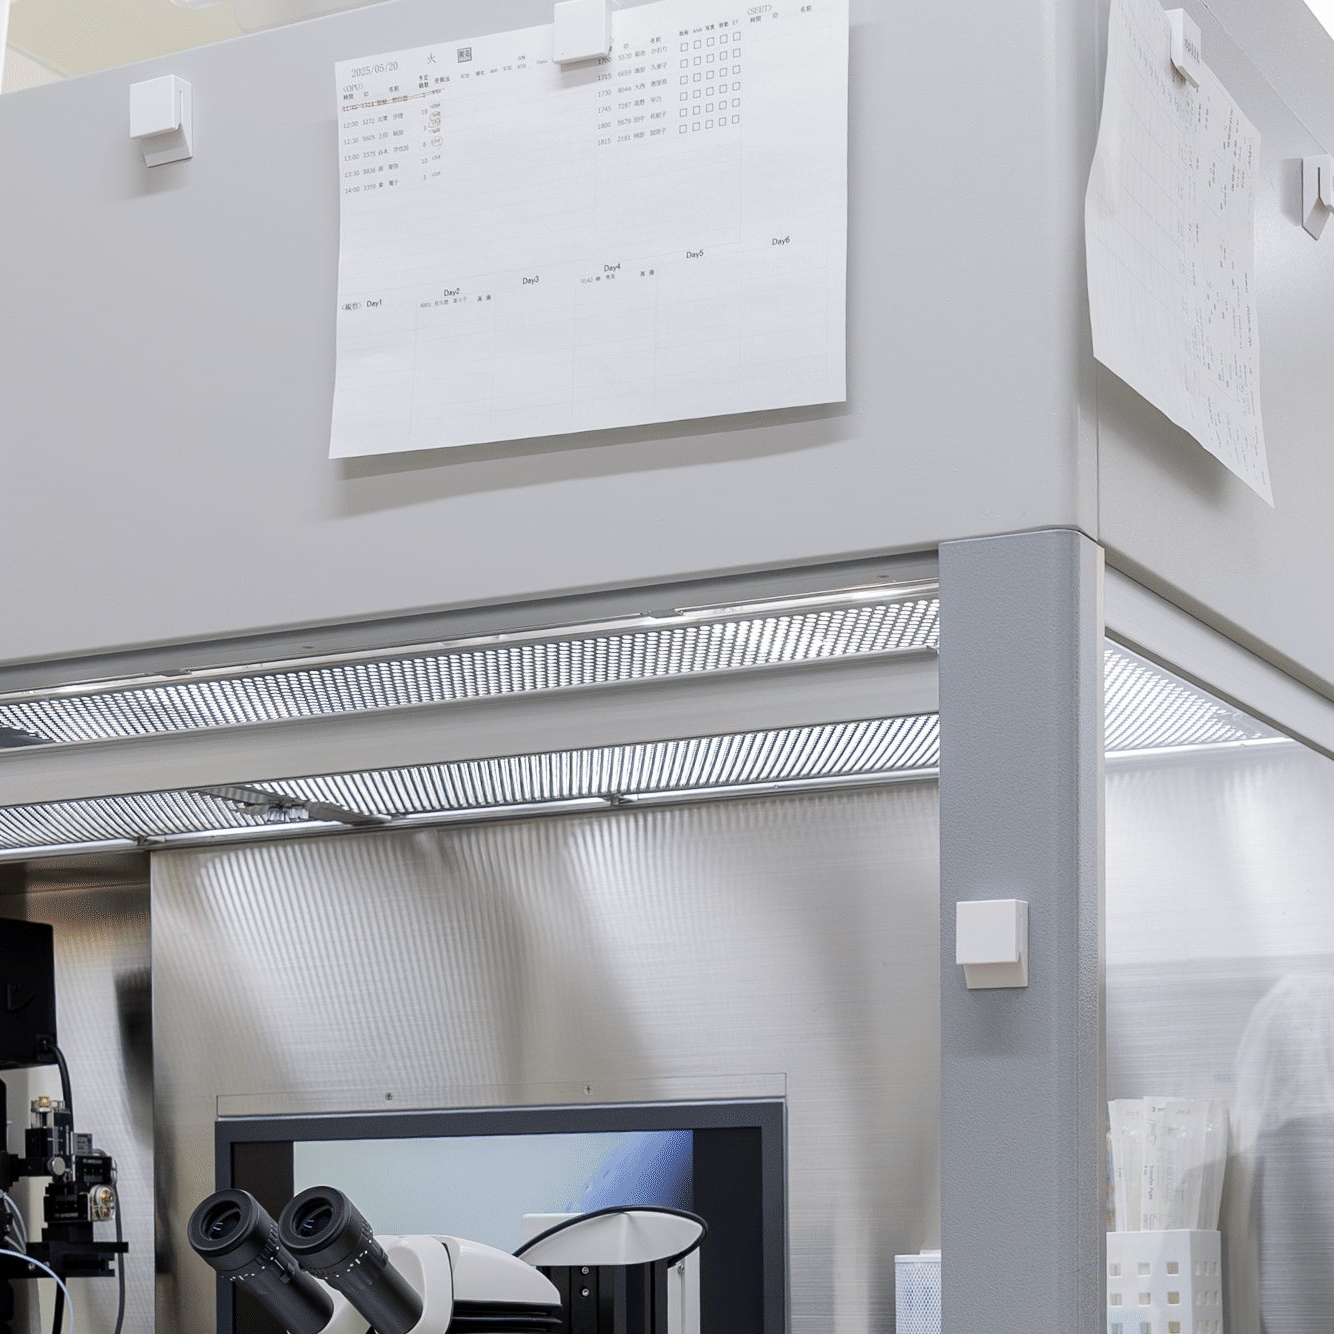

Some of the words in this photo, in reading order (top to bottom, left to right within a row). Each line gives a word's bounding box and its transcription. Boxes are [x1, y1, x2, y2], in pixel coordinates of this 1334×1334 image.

[351, 61, 398, 78] 2025/05/20
[427, 53, 436, 64] 火
[772, 236, 790, 246] Day6
[686, 250, 704, 259] Day5
[603, 263, 621, 272] Day4
[522, 276, 540, 285] Day3
[443, 288, 460, 297] Day2
[366, 299, 382, 308] Day1
